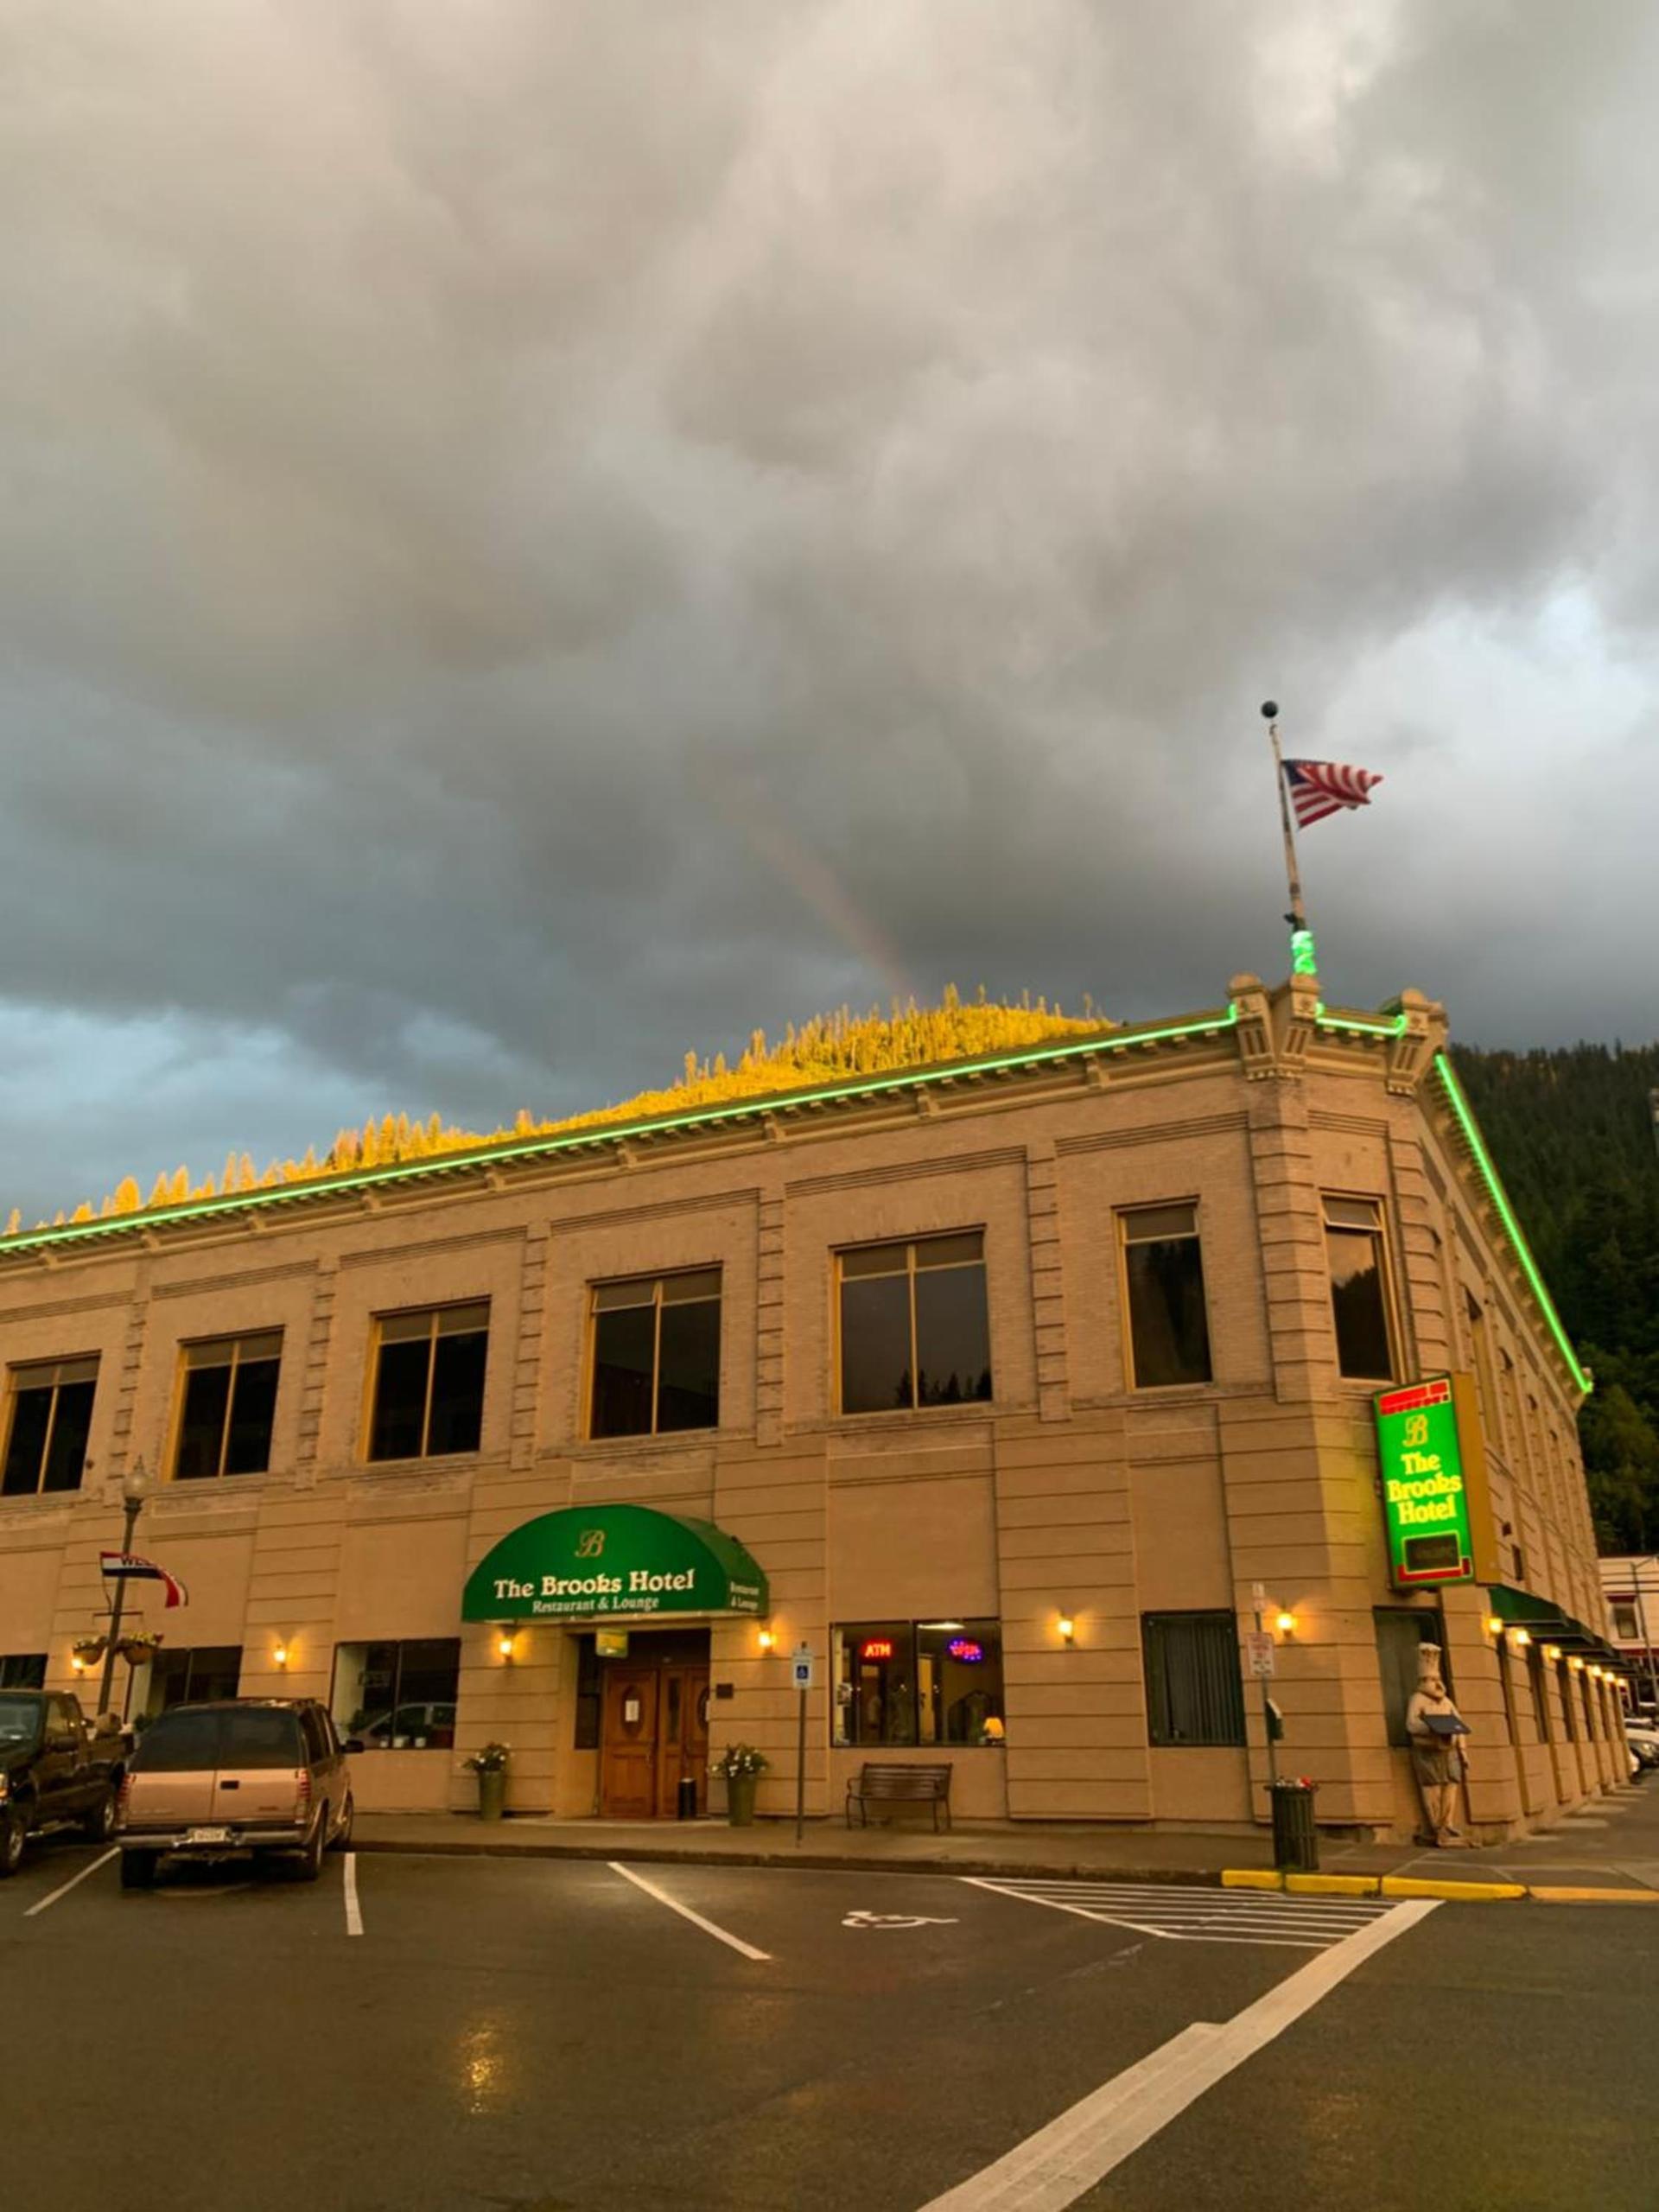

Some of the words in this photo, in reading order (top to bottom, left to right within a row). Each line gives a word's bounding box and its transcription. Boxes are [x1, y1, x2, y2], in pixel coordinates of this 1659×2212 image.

[1402, 1414, 1428, 1447] B
[1400, 1452, 1441, 1476] The
[1387, 1471, 1462, 1503] Brooks
[1397, 1494, 1457, 1525] Hotel
[574, 1529, 606, 1557] B
[493, 1578, 535, 1599] The
[540, 1573, 622, 1597] Brooks
[628, 1568, 696, 1592] Hotel
[532, 1599, 595, 1614] Restaurant
[597, 1596, 609, 1611] &
[612, 1596, 659, 1613] Lounge
[864, 1643, 891, 1658] ATM
